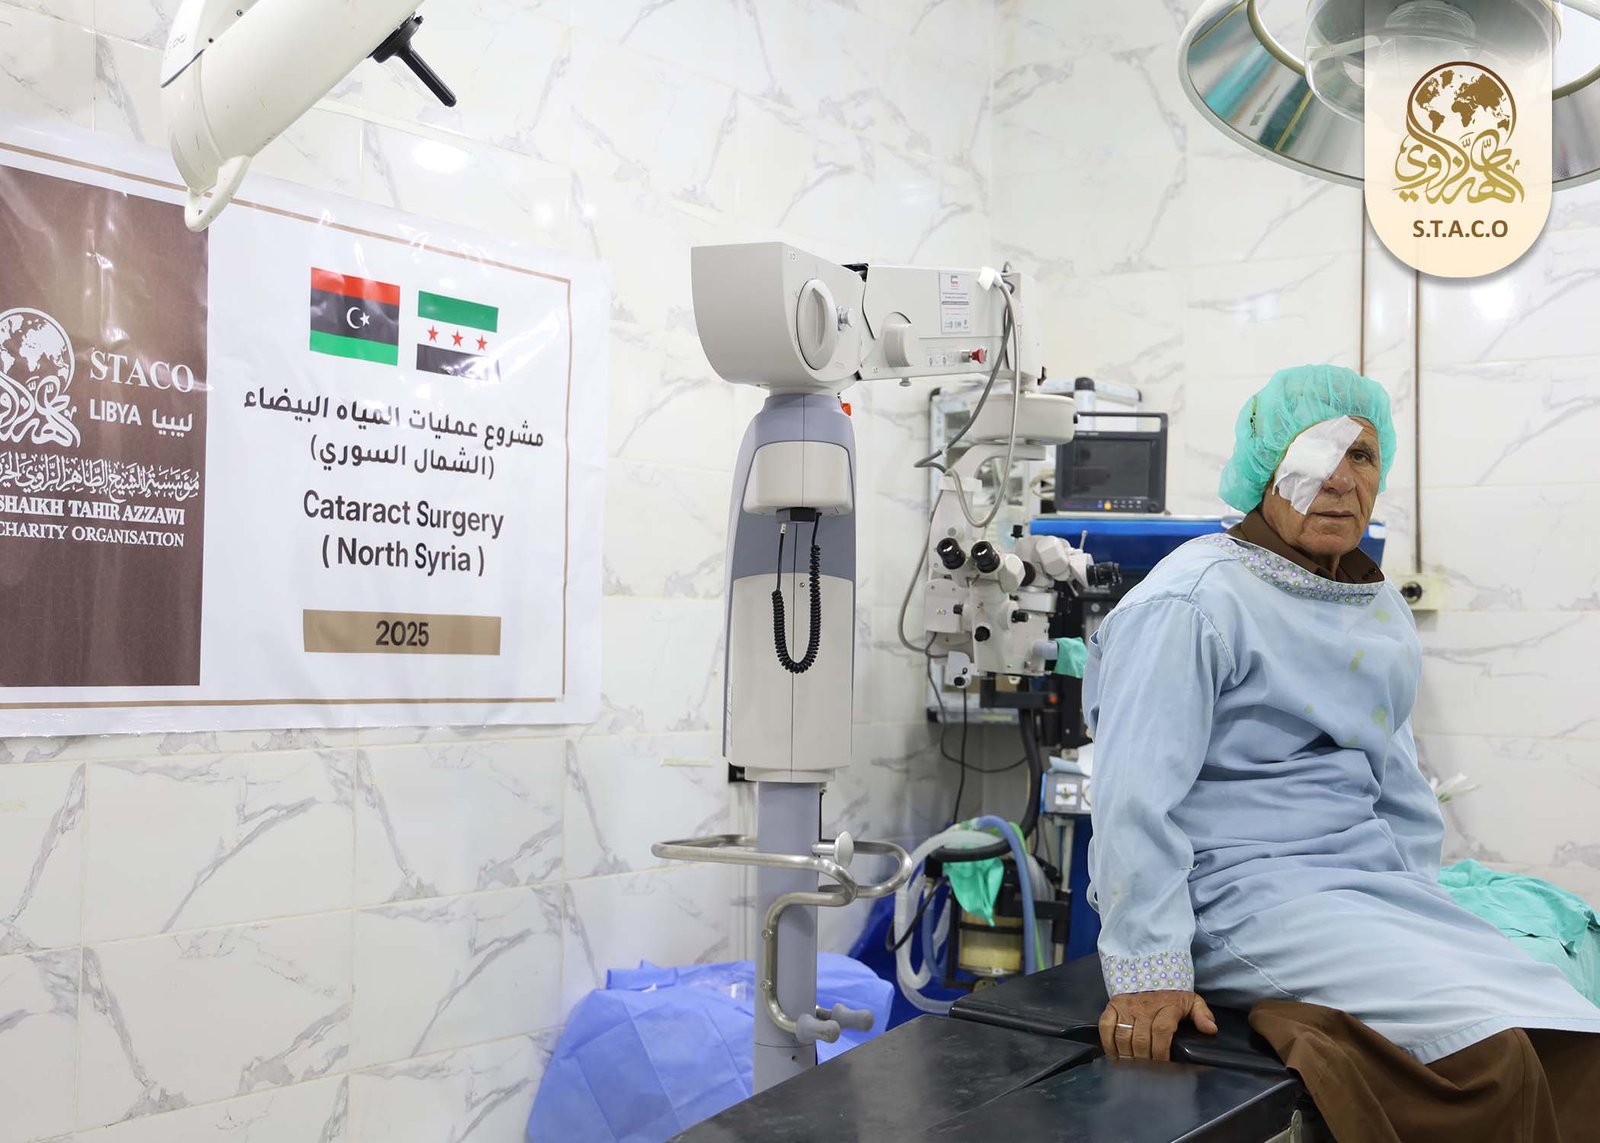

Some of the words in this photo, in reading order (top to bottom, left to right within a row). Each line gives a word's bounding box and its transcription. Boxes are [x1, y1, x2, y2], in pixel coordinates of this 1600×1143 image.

[90, 350, 194, 393] STACO
[90, 398, 142, 426] LIBYA
[243, 387, 329, 423] البيضاء
[336, 400, 400, 430] المياه
[152, 408, 193, 438] ليبيا
[409, 408, 478, 440] عمليات
[484, 420, 544, 450] مشروع
[310, 434, 407, 471] السوري)
[414, 446, 495, 480] (الشمال
[68, 500, 120, 520] TAHIR
[122, 505, 185, 525] AZZAWI
[303, 489, 411, 526] Cataract
[416, 500, 504, 539] Surgery
[71, 526, 185, 547] ORGANISATION
[375, 619, 430, 647] 2025
